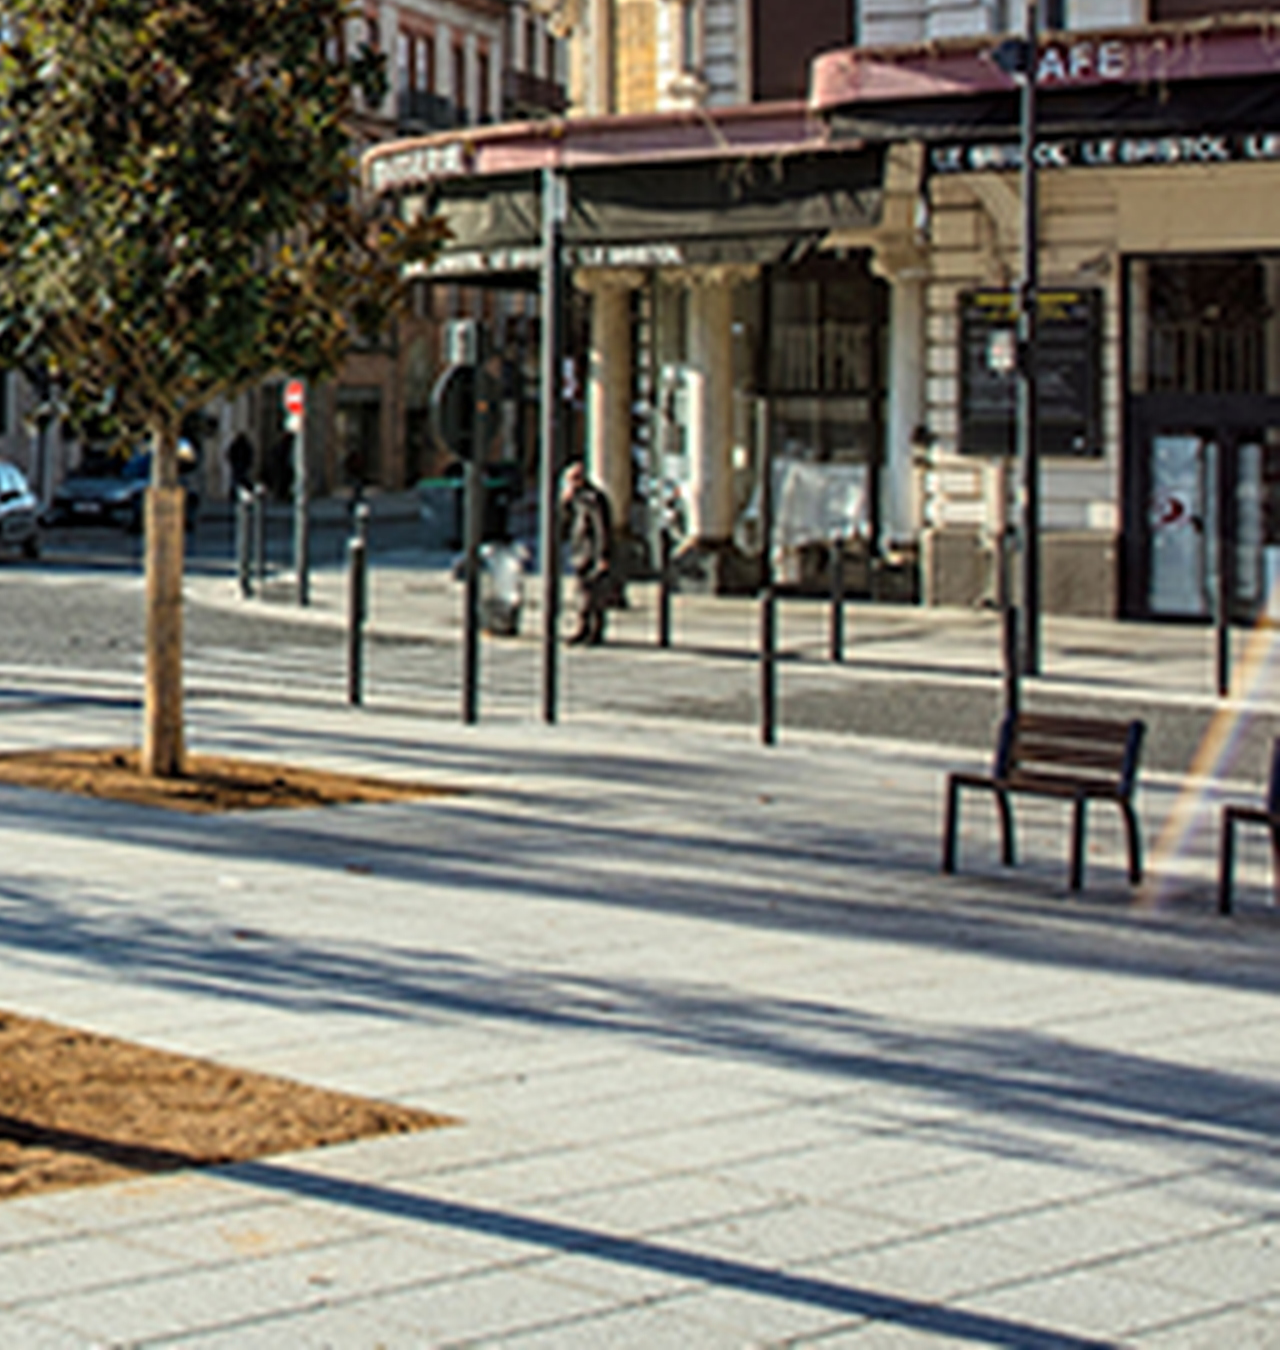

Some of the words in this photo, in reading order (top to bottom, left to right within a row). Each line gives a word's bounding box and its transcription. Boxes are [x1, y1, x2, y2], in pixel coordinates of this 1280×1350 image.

[931, 146, 962, 172] LE
[968, 141, 1068, 170] BRISOL
[1082, 140, 1115, 164] LE
[1119, 135, 1230, 163] BRISTOL
